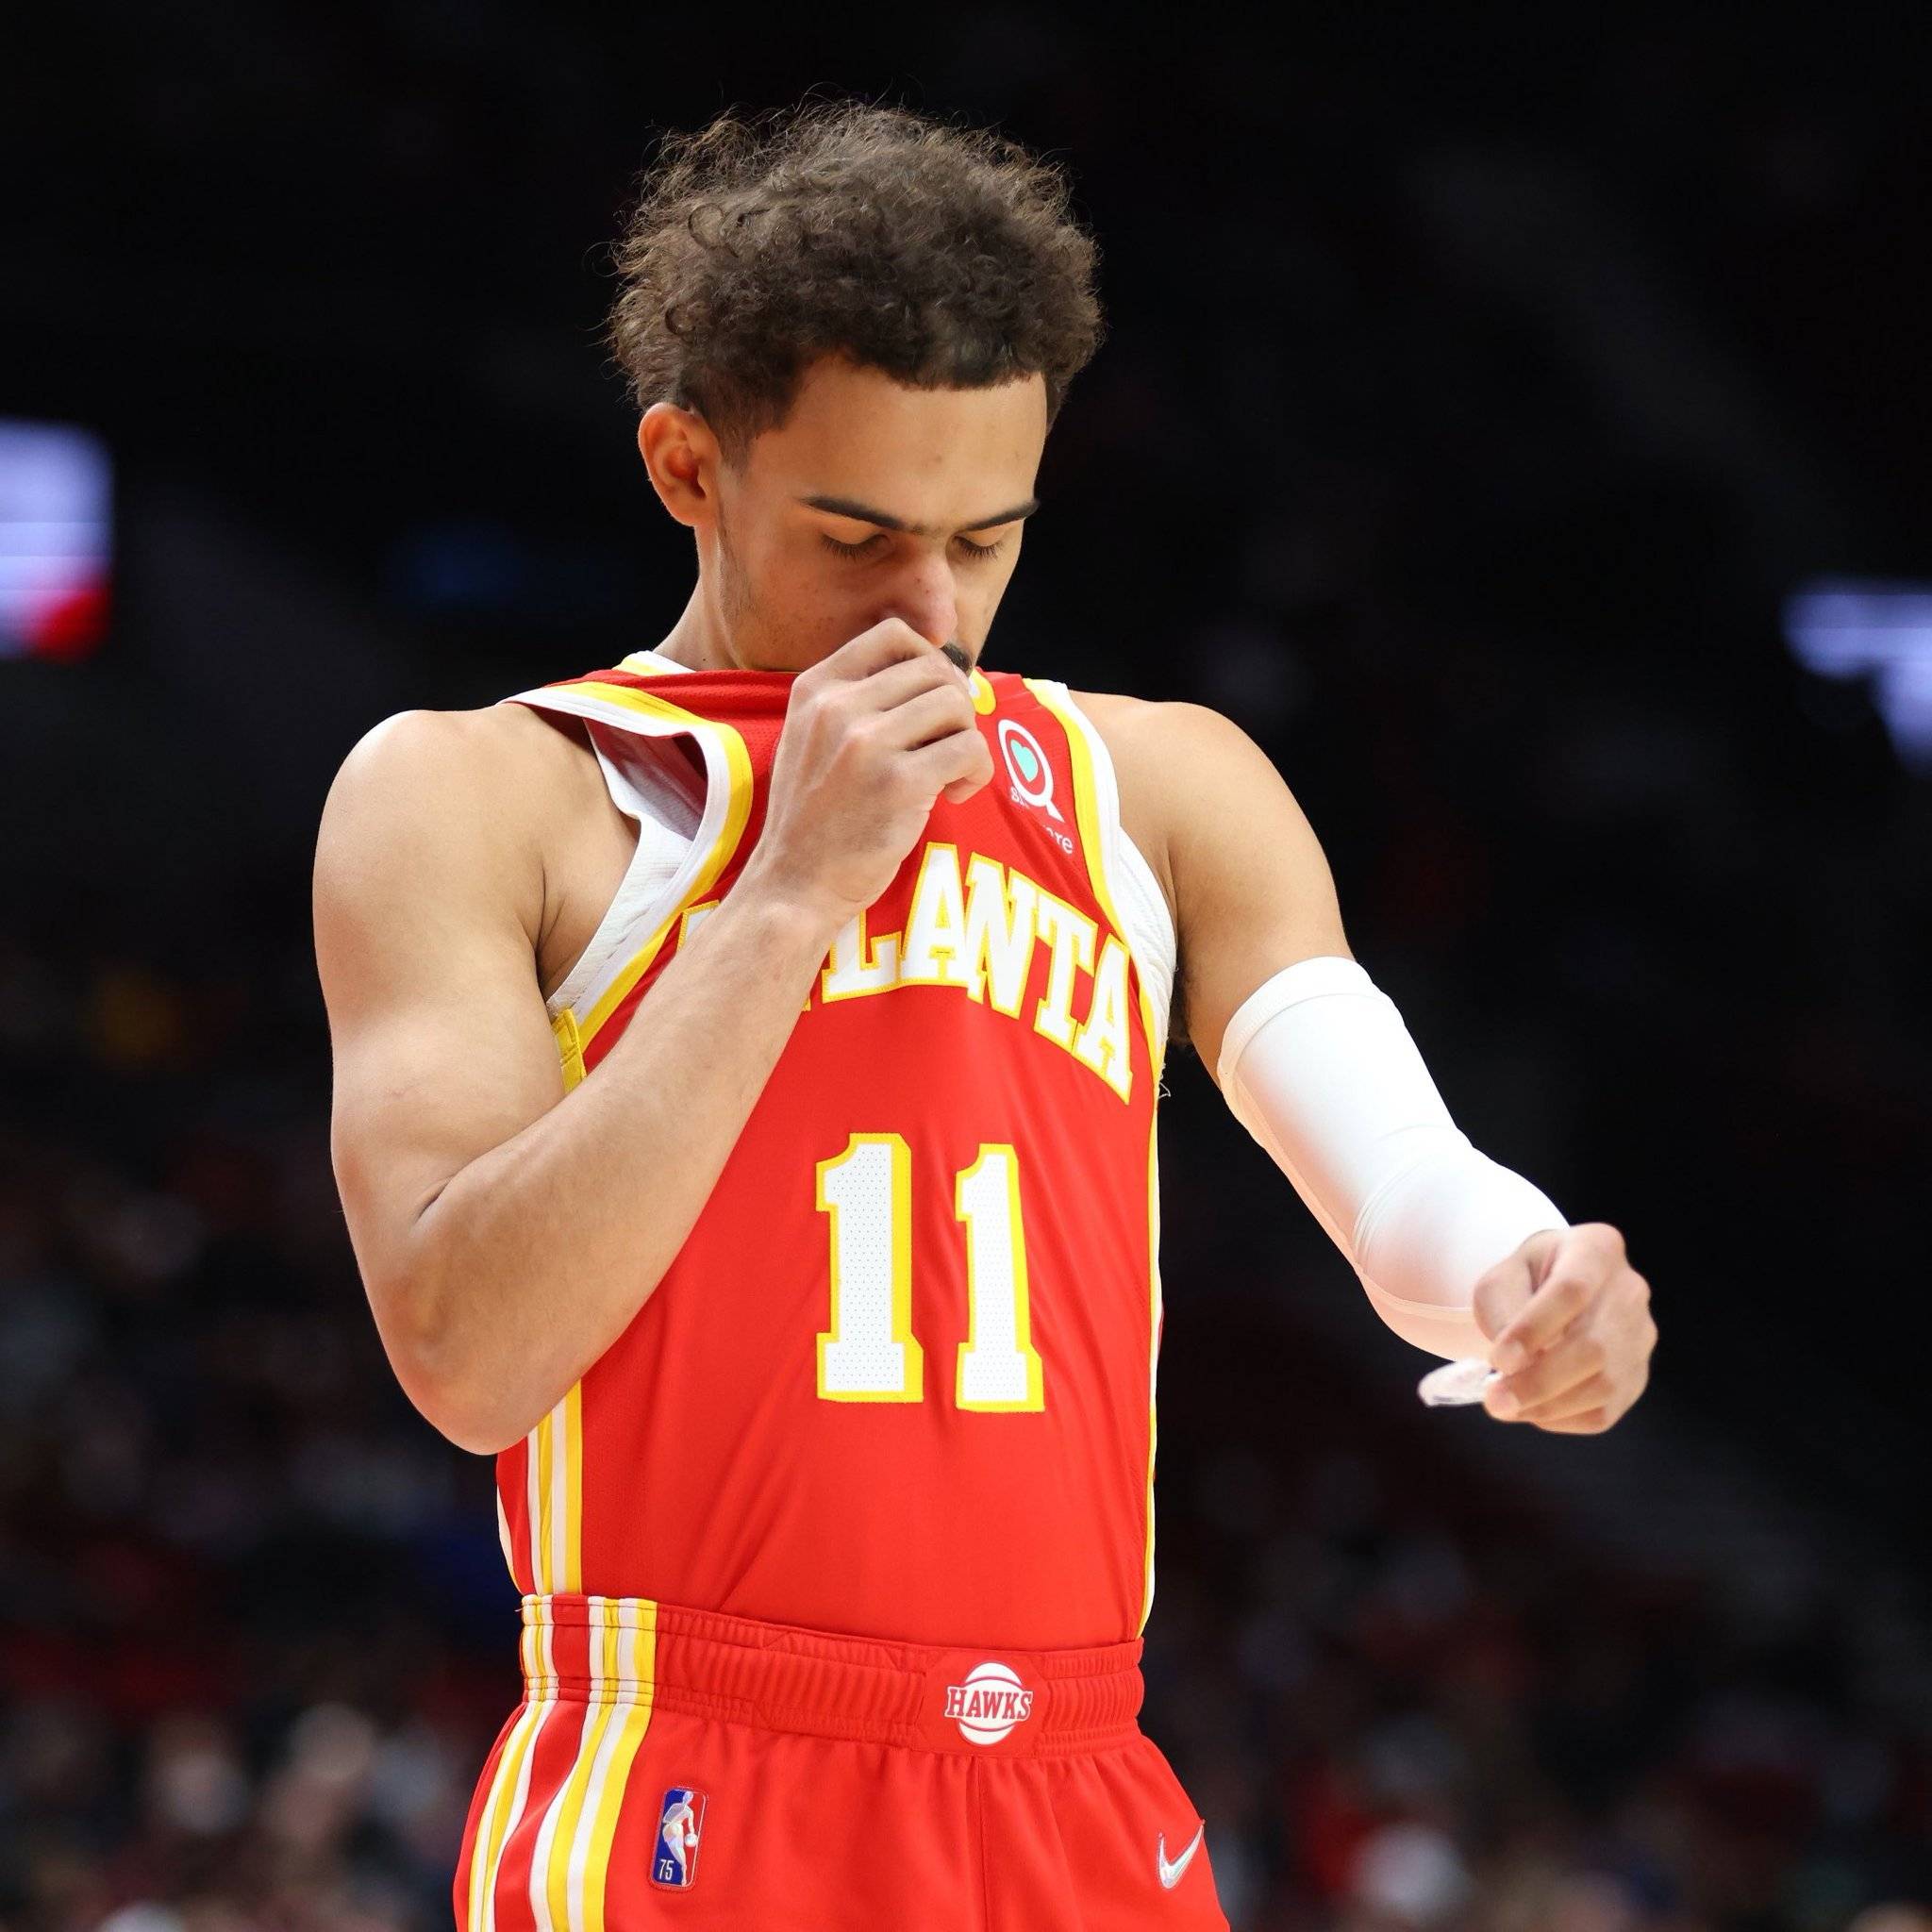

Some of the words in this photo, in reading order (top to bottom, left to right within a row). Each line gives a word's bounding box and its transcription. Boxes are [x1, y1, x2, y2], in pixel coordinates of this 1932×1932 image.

[679, 841, 1132, 1106] LANTA
[816, 1132, 1045, 1413] 11
[944, 1686, 1034, 1722] HAWKS
[658, 1858, 675, 1880] 75
